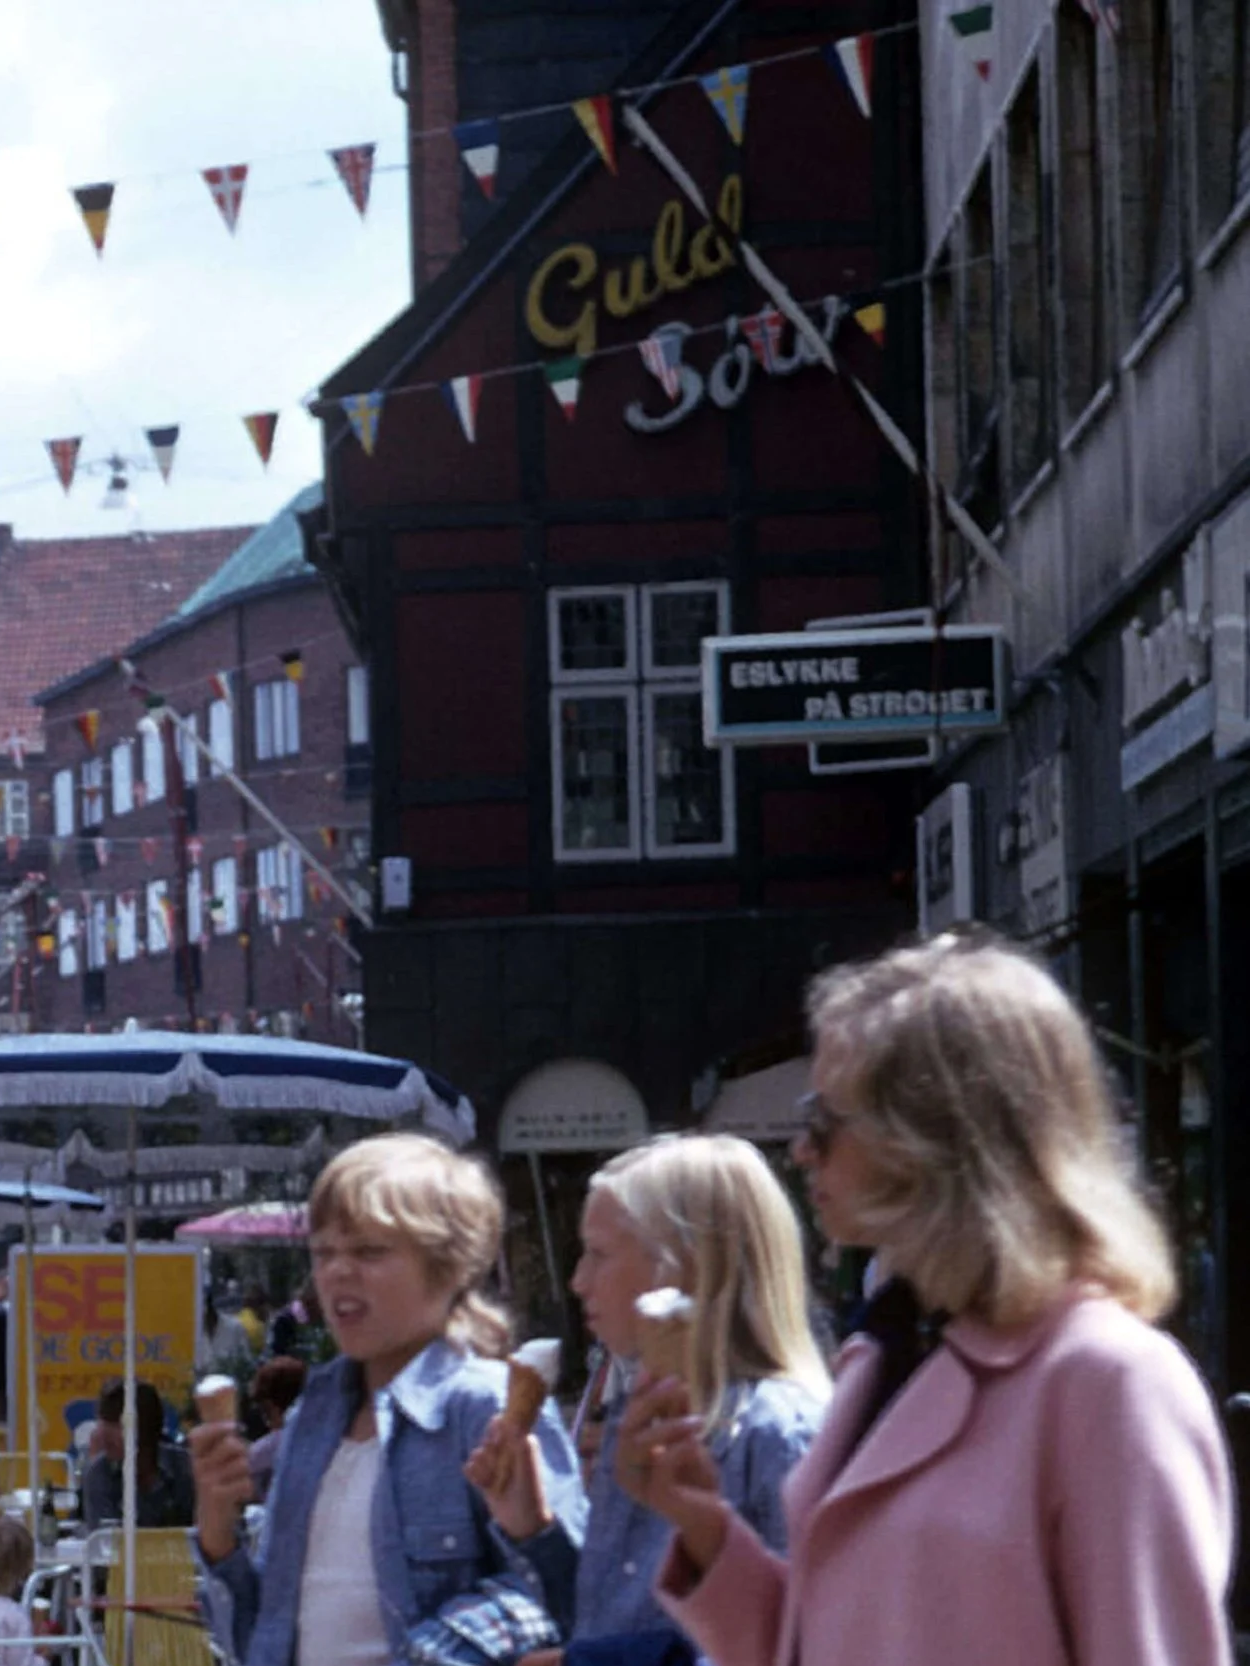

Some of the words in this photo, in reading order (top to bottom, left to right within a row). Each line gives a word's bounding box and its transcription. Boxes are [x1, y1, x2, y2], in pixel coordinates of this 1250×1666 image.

[526, 173, 743, 358] Guld
[804, 690, 843, 721] PÅ
[33, 1263, 126, 1332] SE
